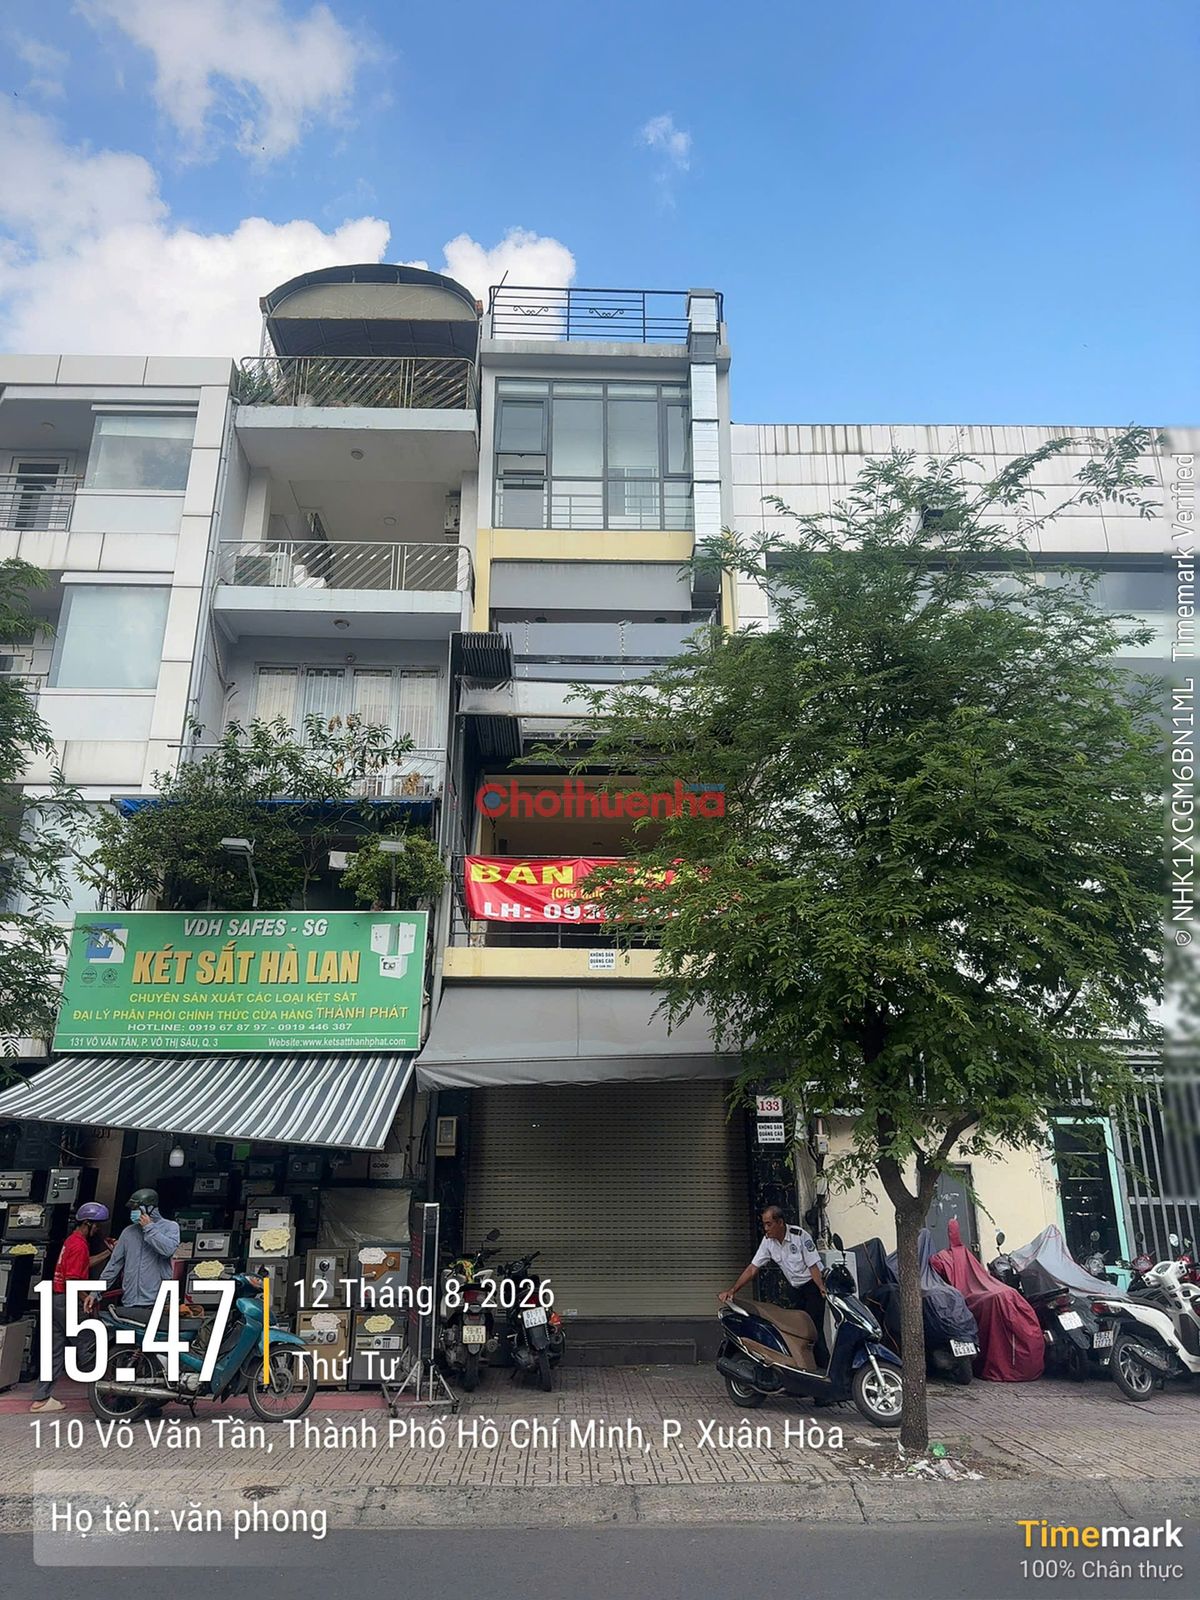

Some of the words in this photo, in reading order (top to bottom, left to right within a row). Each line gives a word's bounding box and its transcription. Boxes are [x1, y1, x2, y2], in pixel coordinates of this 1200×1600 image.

[470, 862, 574, 885] BÁN
[483, 901, 532, 919] LH:
[184, 918, 224, 936] VDH
[226, 918, 287, 936] SAFES
[302, 918, 329, 936] SG
[132, 943, 192, 984] KÉT
[195, 940, 255, 984] SẮT
[258, 943, 299, 984] HÀ
[305, 950, 361, 984] LAN
[129, 992, 179, 1003] CHUYÊN
[246, 990, 272, 1003] CÁC
[275, 993, 304, 1005] LOẠI
[73, 1010, 92, 1022] ĐẠI
[95, 1008, 110, 1020] LÝ
[178, 1008, 214, 1020] CHÍNH
[316, 1006, 365, 1019] THÀNH
[369, 1004, 409, 1018] PHÁT
[127, 1024, 185, 1032] HOTLINE:
[253, 1023, 267, 1031] 97
[278, 1023, 305, 1031] 0919
[308, 1023, 329, 1031] 446
[70, 1037, 84, 1047] 131
[141, 1037, 149, 1047] P.
[202, 1037, 212, 1047] Q.
[213, 1037, 218, 1046] 3
[760, 1101, 779, 1111] 133
